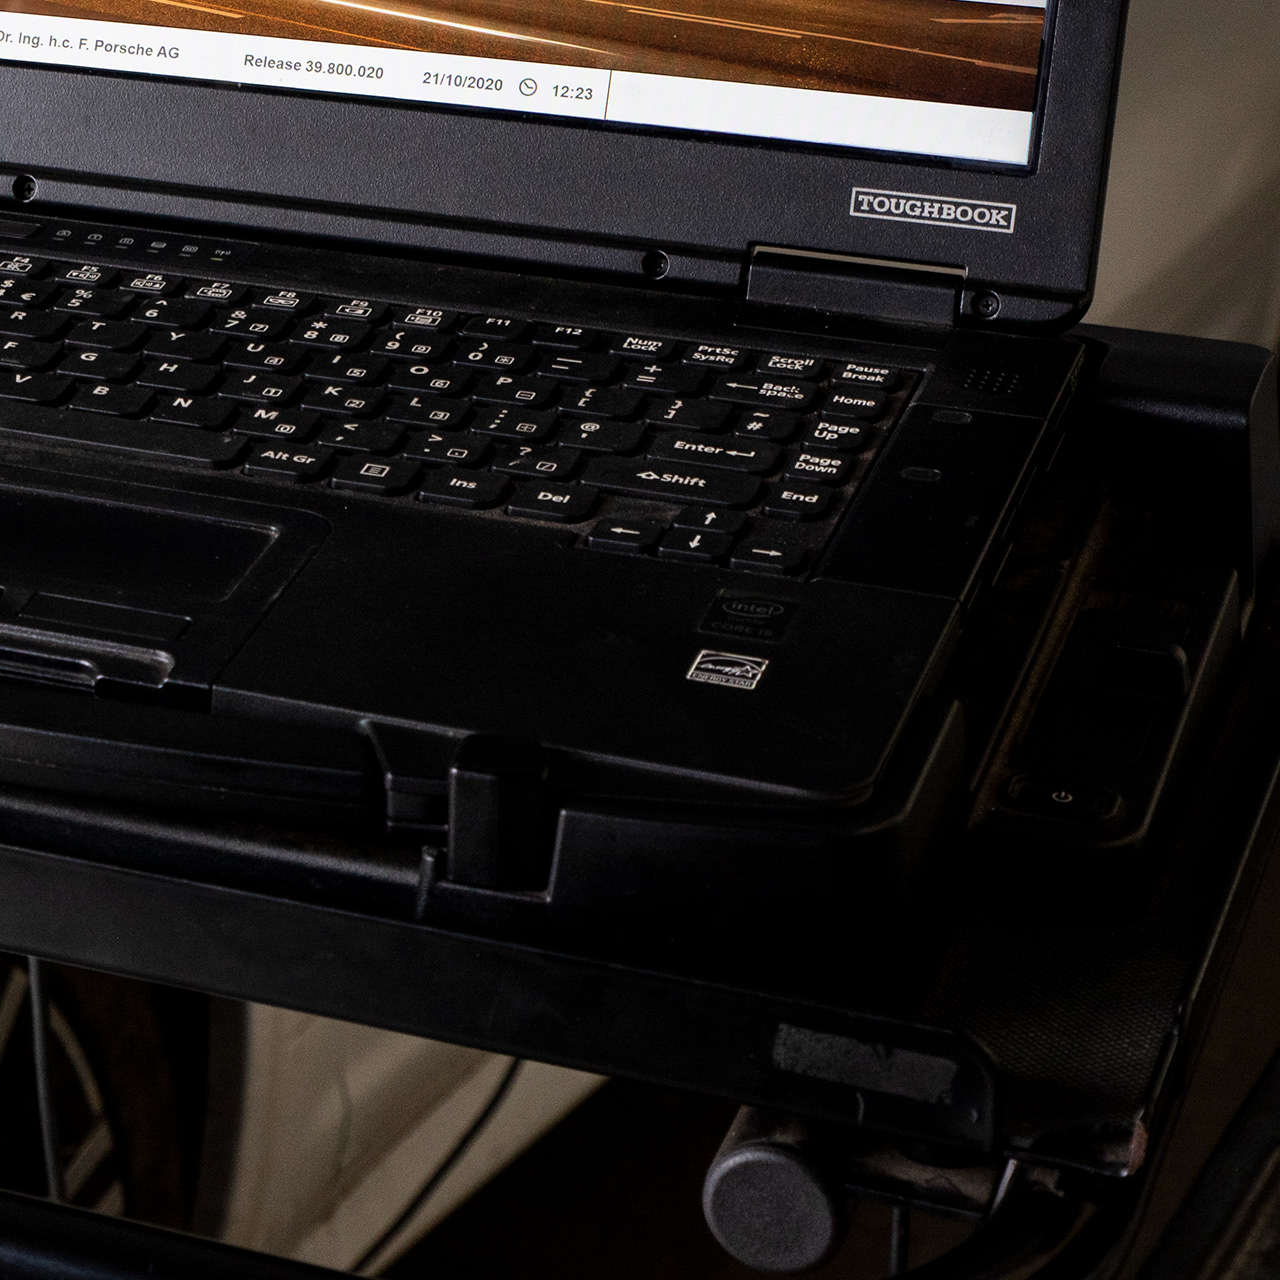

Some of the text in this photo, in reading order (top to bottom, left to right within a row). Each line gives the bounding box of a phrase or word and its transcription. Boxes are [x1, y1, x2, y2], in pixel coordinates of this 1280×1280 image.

[18, 31, 44, 47] Ing.
[48, 35, 74, 50] h.c.
[78, 38, 90, 50] F.
[93, 41, 154, 59] Porsche
[156, 45, 180, 59] AG
[243, 53, 385, 80] Release 39.800.020
[421, 71, 504, 92] 21/10/2020
[552, 83, 593, 100] 12:23
[858, 194, 1009, 226] TOUGHBOOK
[13, 256, 31, 264] F4
[145, 273, 163, 281] F6
[67, 298, 83, 307] 5
[10, 311, 28, 320] R
[144, 309, 160, 318] 6
[415, 308, 444, 317] F10
[91, 321, 107, 331] T
[224, 319, 240, 328] 7
[485, 317, 512, 327] F11
[169, 332, 186, 341] Y
[303, 330, 320, 340] 8
[554, 326, 583, 336] F12
[3, 341, 19, 350] F
[384, 341, 401, 350] 9
[625, 336, 663, 347] Num
[246, 343, 266, 352] U
[622, 343, 658, 352] Lock
[697, 345, 740, 356] PrtSc
[80, 352, 99, 362] G
[692, 352, 736, 365] SysRq
[771, 355, 815, 367] Scroll
[158, 362, 179, 373] H
[767, 361, 804, 371] Lock
[846, 363, 890, 375] Pause
[15, 374, 32, 384] V
[242, 374, 257, 384] J
[495, 376, 514, 386] P
[842, 371, 885, 383] Break
[92, 385, 110, 396] B
[324, 386, 344, 396] K
[172, 397, 194, 408] N
[409, 397, 422, 407] L
[832, 395, 876, 407] Home
[253, 409, 280, 420] M
[817, 422, 860, 434] Page
[814, 431, 838, 441] Up
[673, 440, 725, 454] Enter
[260, 450, 316, 465] Alt Gr
[799, 453, 842, 467] Page
[794, 462, 838, 474] Down
[449, 477, 478, 489] Ins
[660, 473, 707, 488] Shift
[537, 491, 571, 504] Del
[781, 490, 819, 503] End
